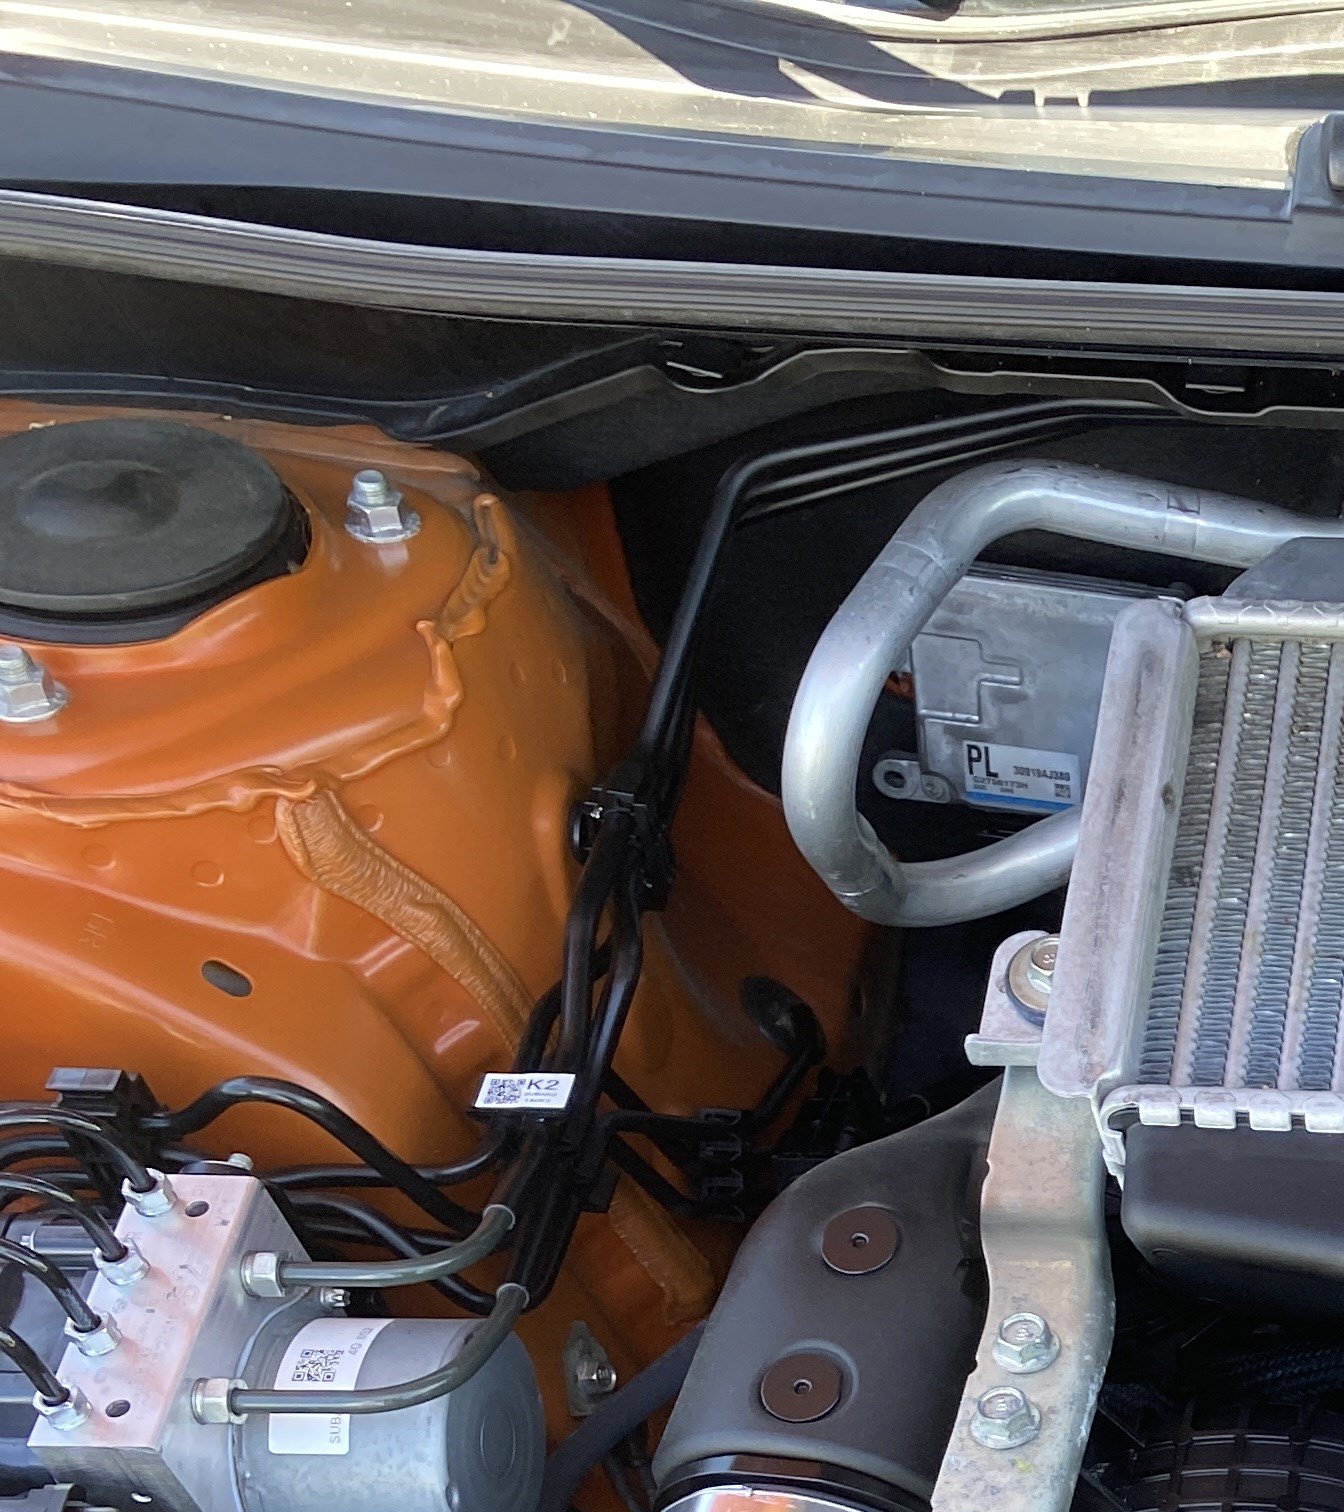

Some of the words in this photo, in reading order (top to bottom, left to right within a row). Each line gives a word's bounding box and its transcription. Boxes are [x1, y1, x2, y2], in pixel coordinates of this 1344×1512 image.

[966, 744, 999, 778] PL
[527, 1078, 560, 1091] K2
[330, 1413, 342, 1444] SUB
